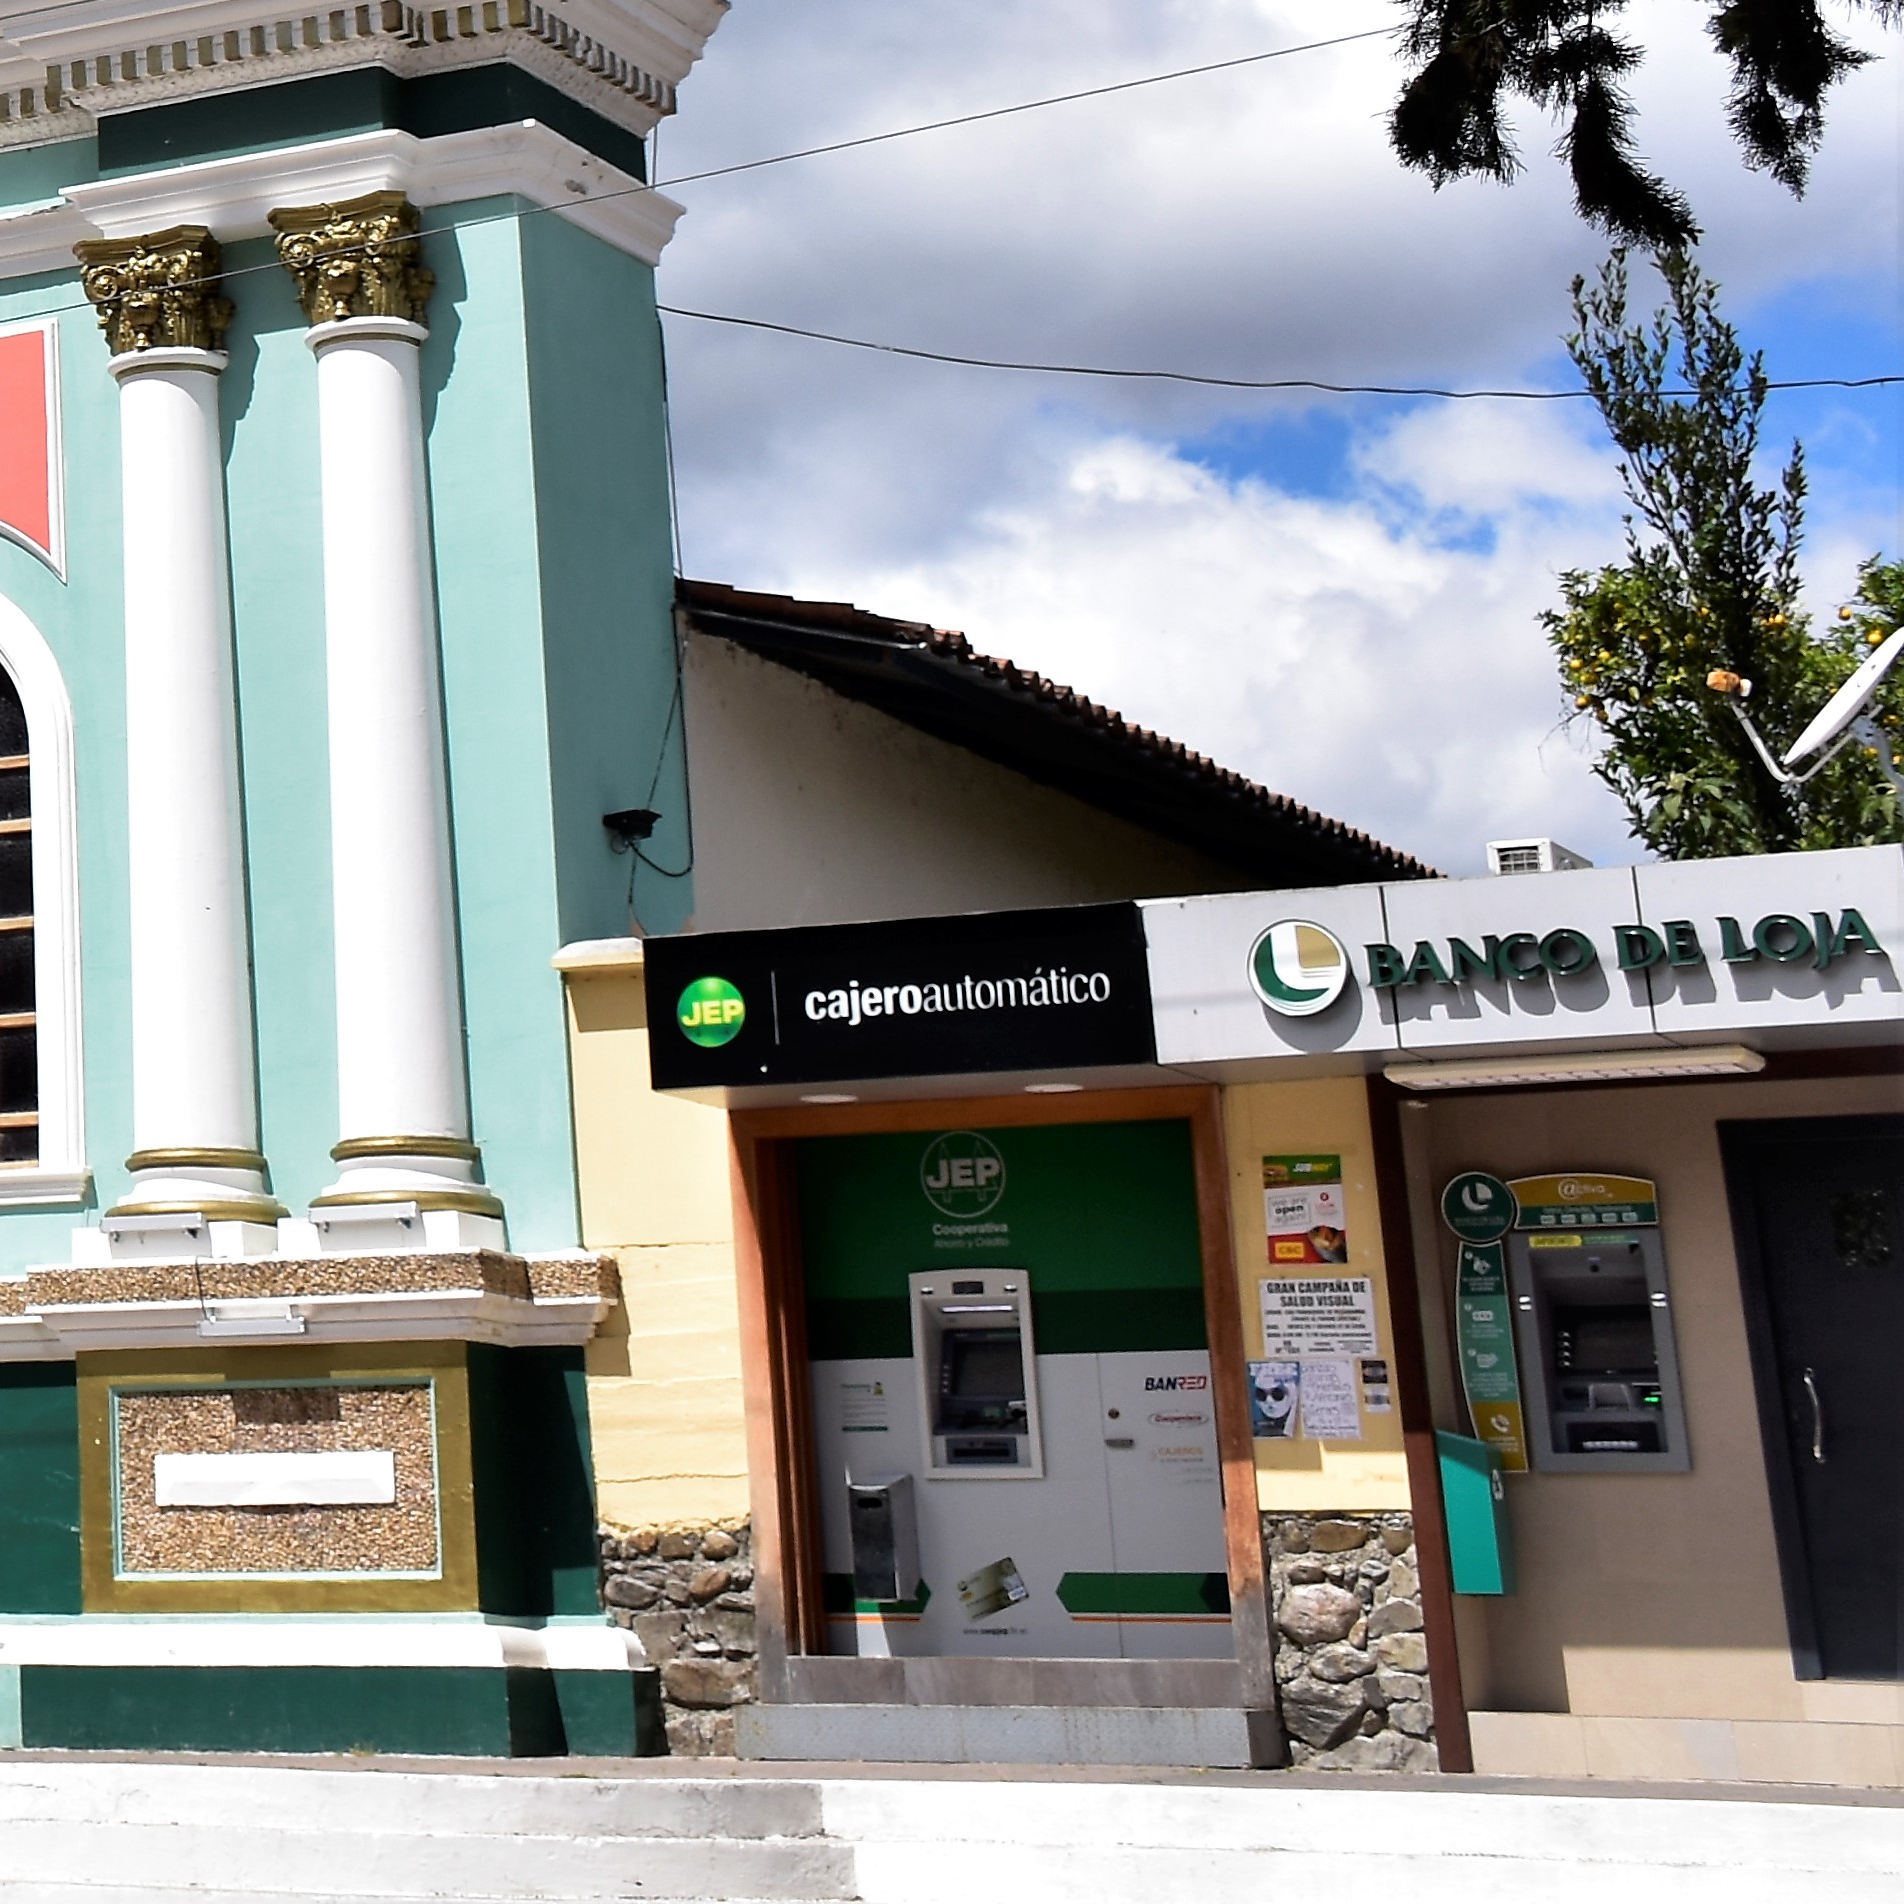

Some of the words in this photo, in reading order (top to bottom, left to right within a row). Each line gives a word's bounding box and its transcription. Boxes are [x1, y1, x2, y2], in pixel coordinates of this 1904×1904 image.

[1364, 927, 1598, 987] BANCO
[1611, 919, 1704, 971] DE
[1714, 907, 1883, 971] LOJA
[804, 967, 1111, 1026] cajeroautomático
[681, 998, 745, 1027] JEP
[926, 1157, 1000, 1188] JEP
[1266, 1282, 1296, 1293] GRAN
[1298, 1280, 1350, 1293] CAMPAÑA
[1352, 1282, 1365, 1293] DE
[1280, 1296, 1314, 1306] SALUD
[1316, 1296, 1354, 1306] VISUAL
[1145, 1376, 1207, 1391] BANRED
